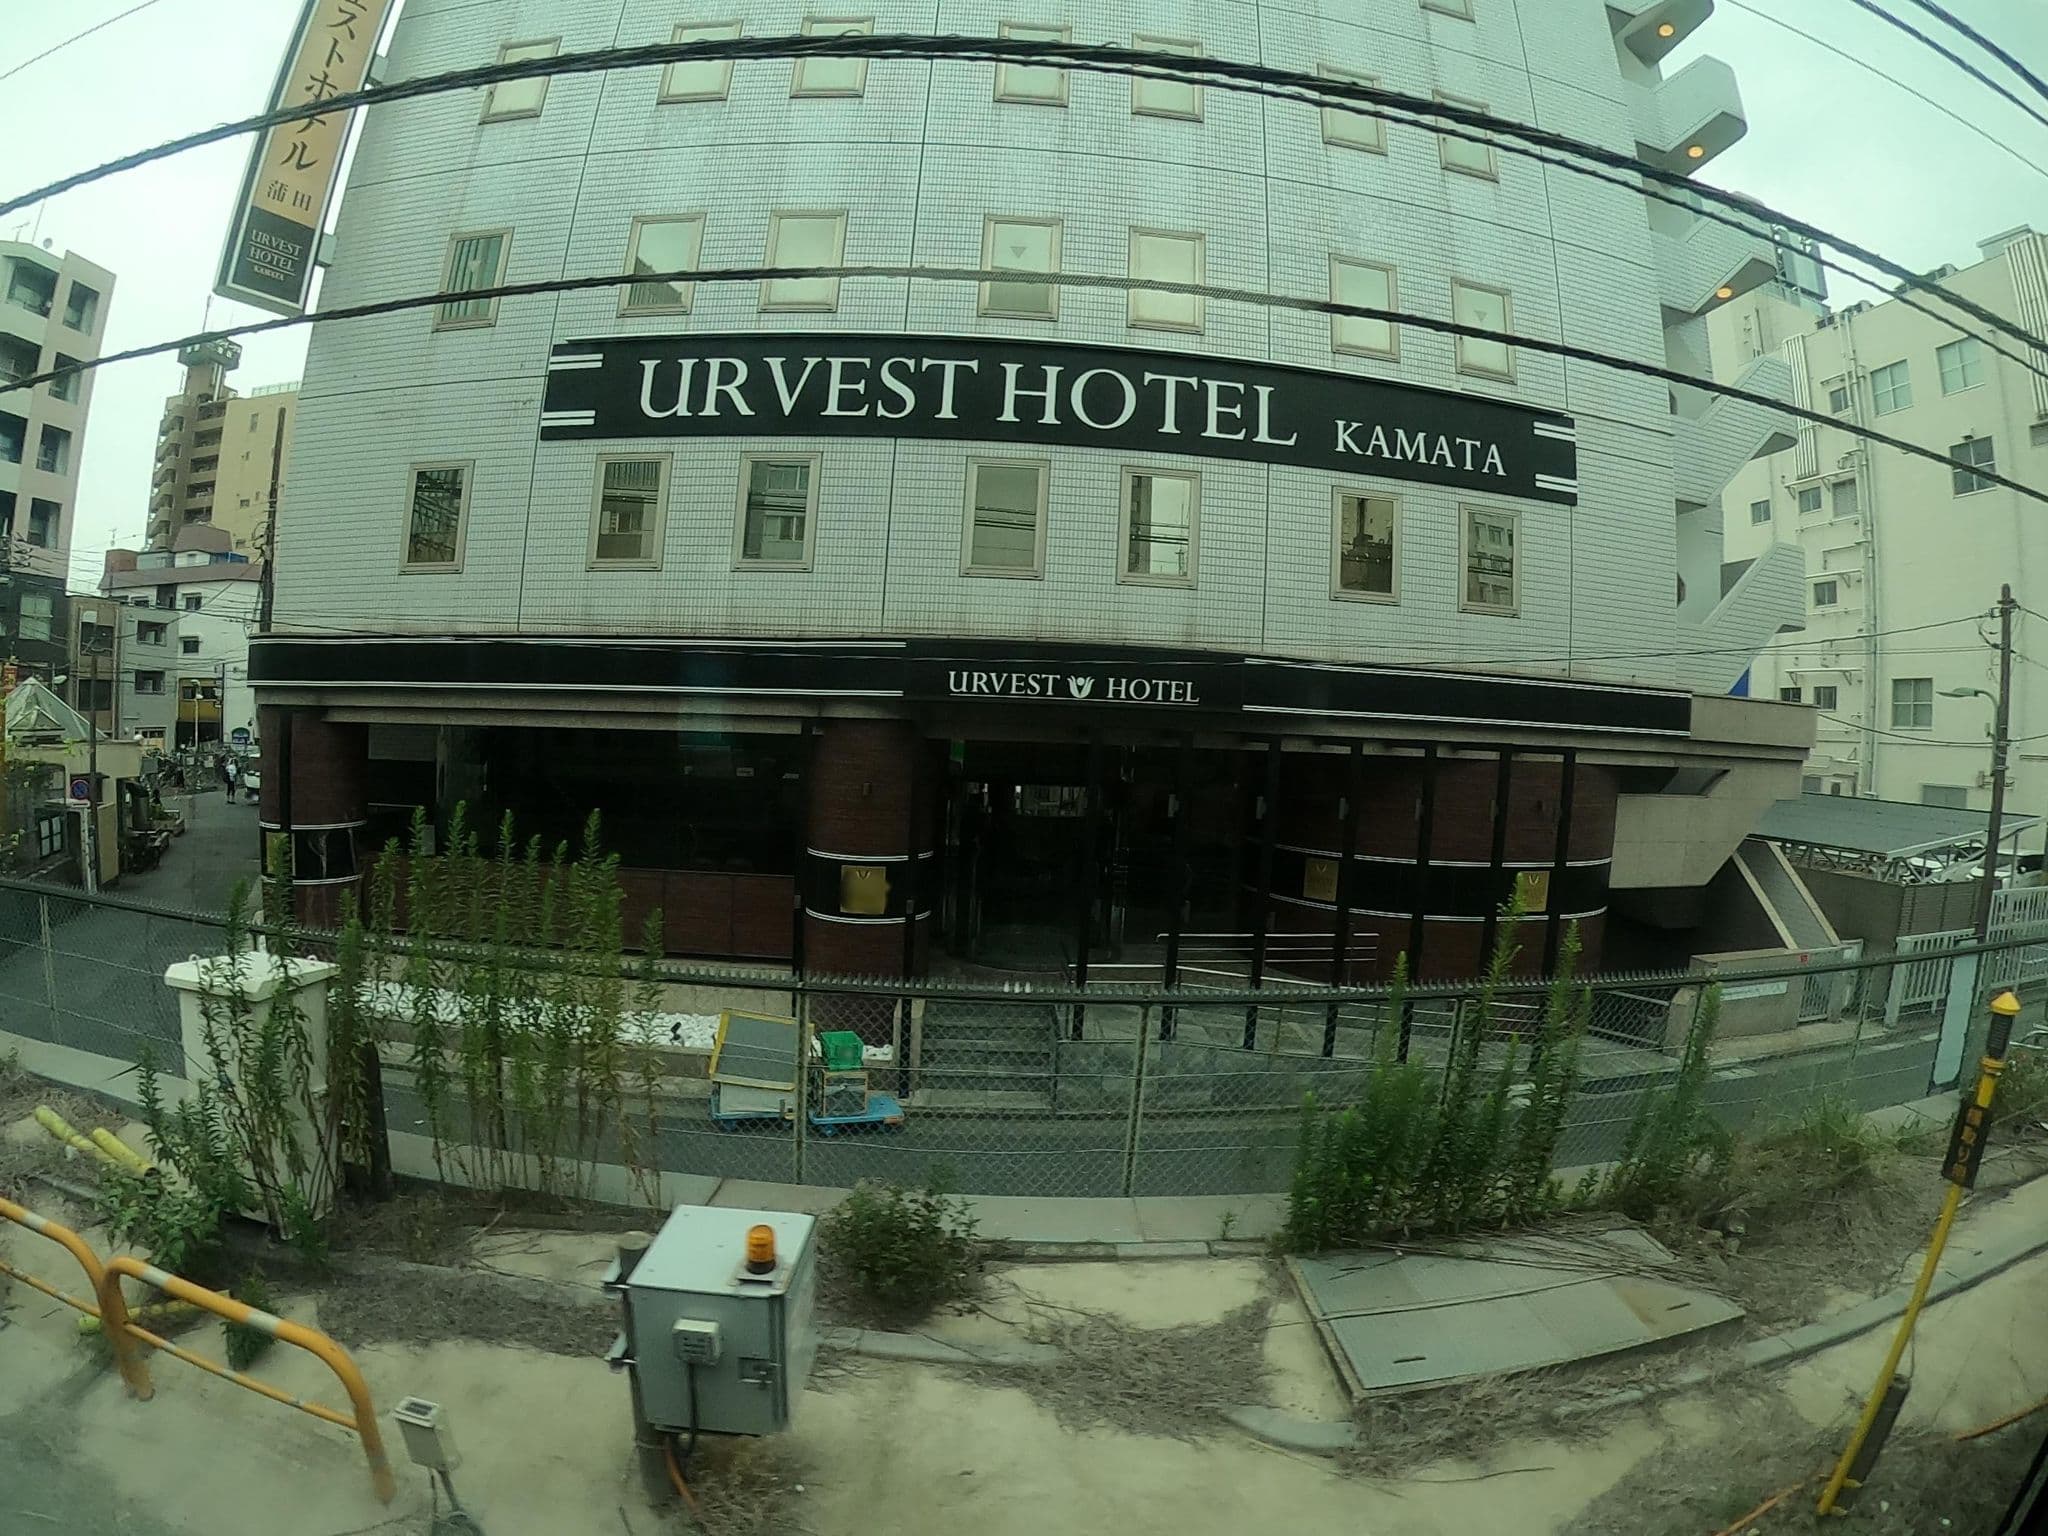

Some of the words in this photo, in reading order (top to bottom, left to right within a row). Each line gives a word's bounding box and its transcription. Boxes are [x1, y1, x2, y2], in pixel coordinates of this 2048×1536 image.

[251, 229, 302, 256] URVEST
[249, 246, 295, 272] HOTEL
[638, 356, 979, 419] URVEST
[996, 362, 1298, 447] HOTEL
[1334, 419, 1507, 477] KAMATA
[949, 670, 1061, 697] URVEST
[1106, 677, 1200, 703] HOTEL
